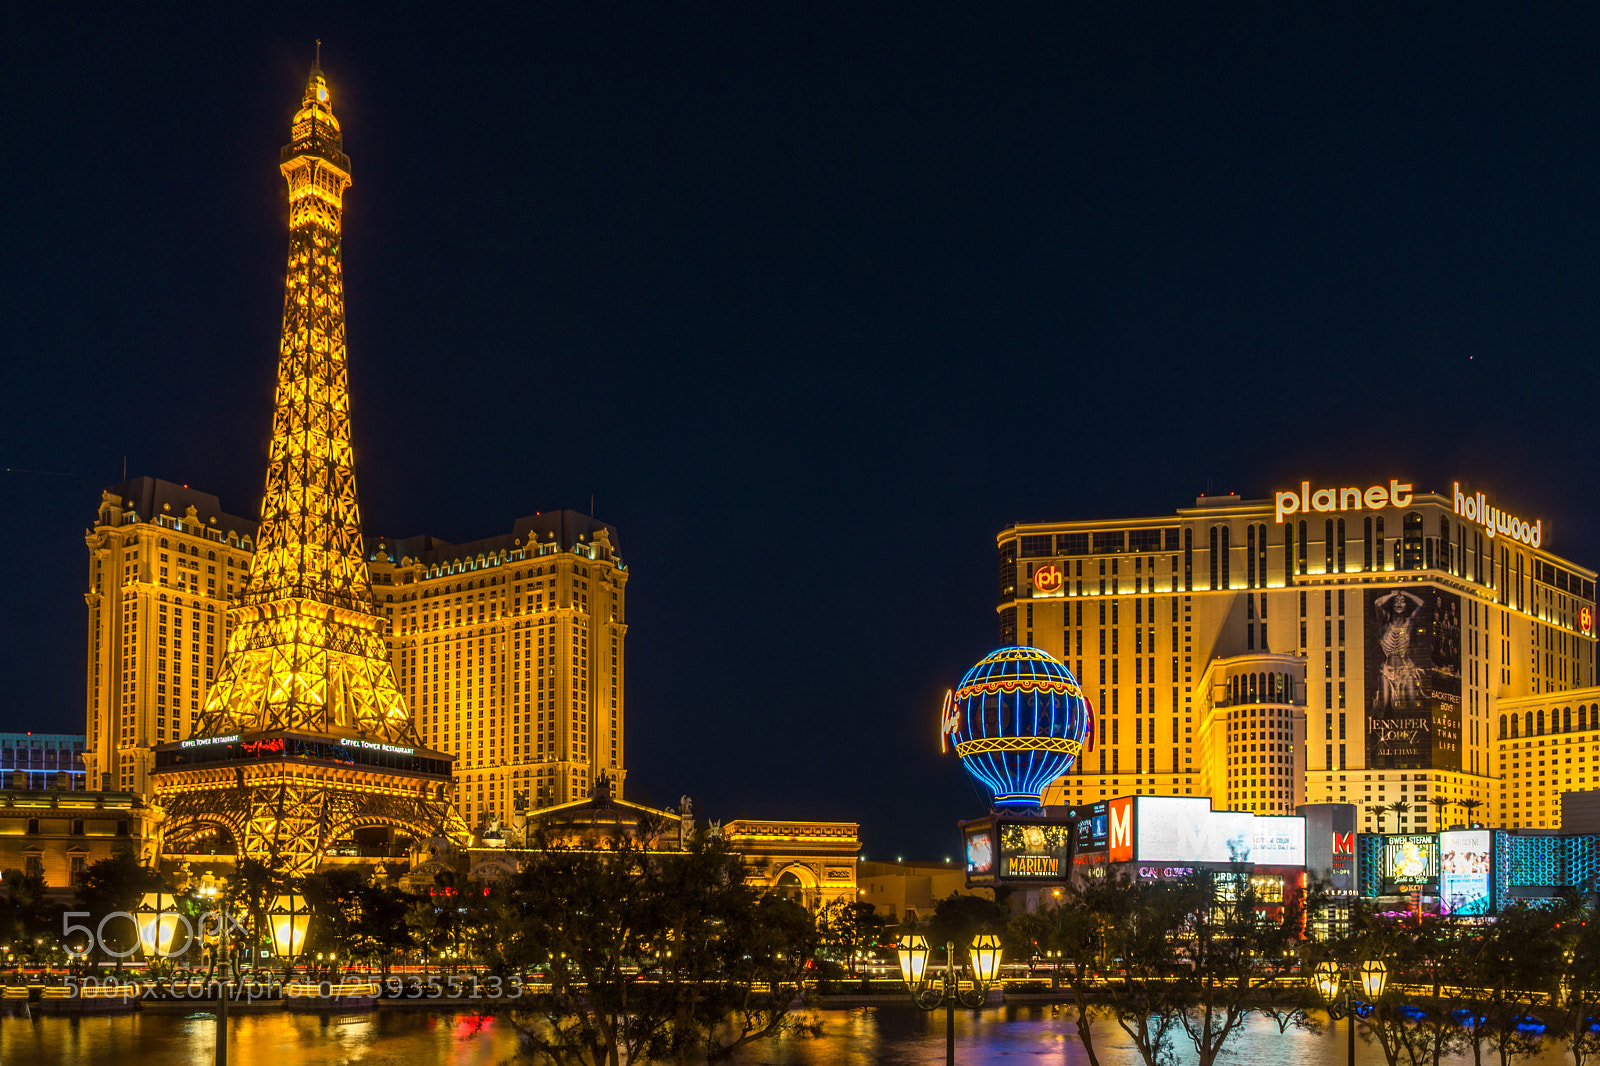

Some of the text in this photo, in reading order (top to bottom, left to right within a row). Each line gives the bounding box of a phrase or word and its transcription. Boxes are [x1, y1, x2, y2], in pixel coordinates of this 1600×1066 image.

[1275, 479, 1413, 523] planet
[1453, 481, 1541, 548] hollywood
[1431, 689, 1461, 704] BACKSTREET
[1440, 702, 1454, 712] BOYS
[1368, 716, 1430, 734] JENNIFER
[1432, 716, 1461, 729] LARGER
[1380, 728, 1420, 744] LOPEZ
[1438, 728, 1458, 740] THAN
[196, 738, 211, 746] TOWER
[340, 738, 415, 755] EIFFEL TOWER RESTAURANT
[1439, 740, 1456, 752] LIFE
[1111, 804, 1131, 849] M
[1332, 831, 1354, 855] M
[1388, 836, 1433, 845] GWEN STEFANI
[1009, 857, 1059, 874] MARILYN!
[1093, 853, 1108, 863] MILE
[1213, 872, 1246, 881] URBAN
